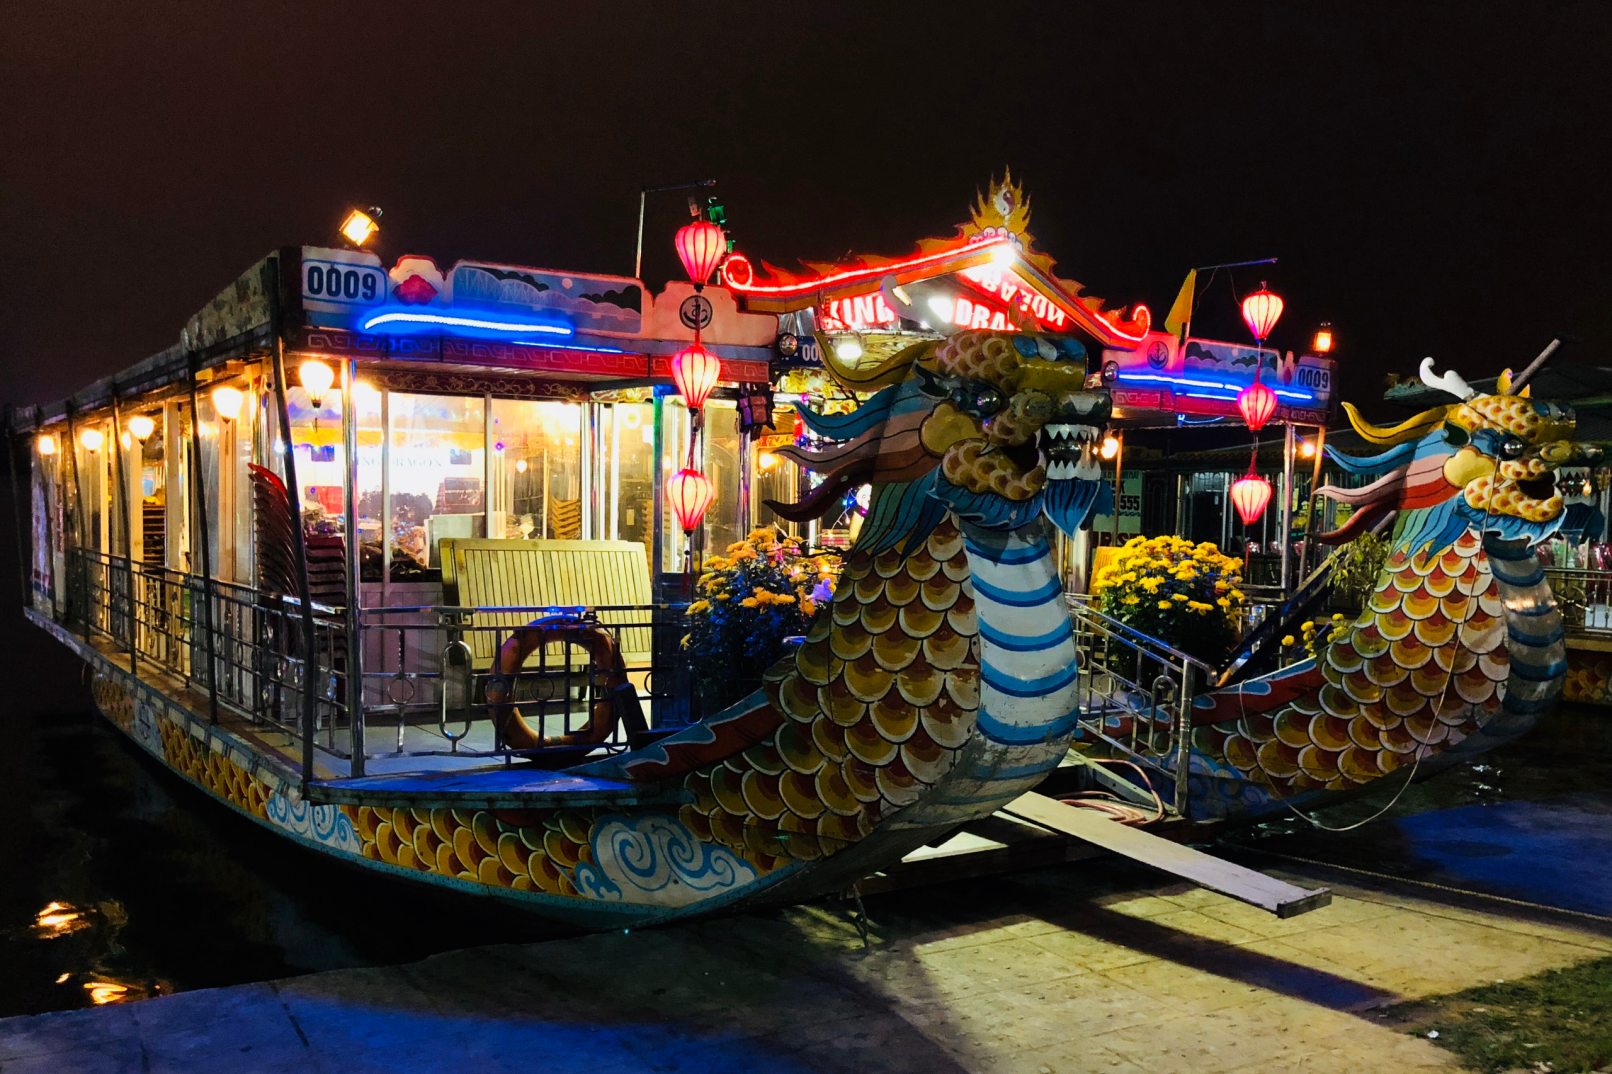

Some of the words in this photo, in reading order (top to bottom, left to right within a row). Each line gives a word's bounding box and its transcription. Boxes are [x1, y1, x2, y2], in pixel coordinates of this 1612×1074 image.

[307, 265, 376, 301] 0009
[954, 297, 1017, 331] DRA
[802, 343, 822, 362] 00
[1297, 368, 1329, 389] 0009
